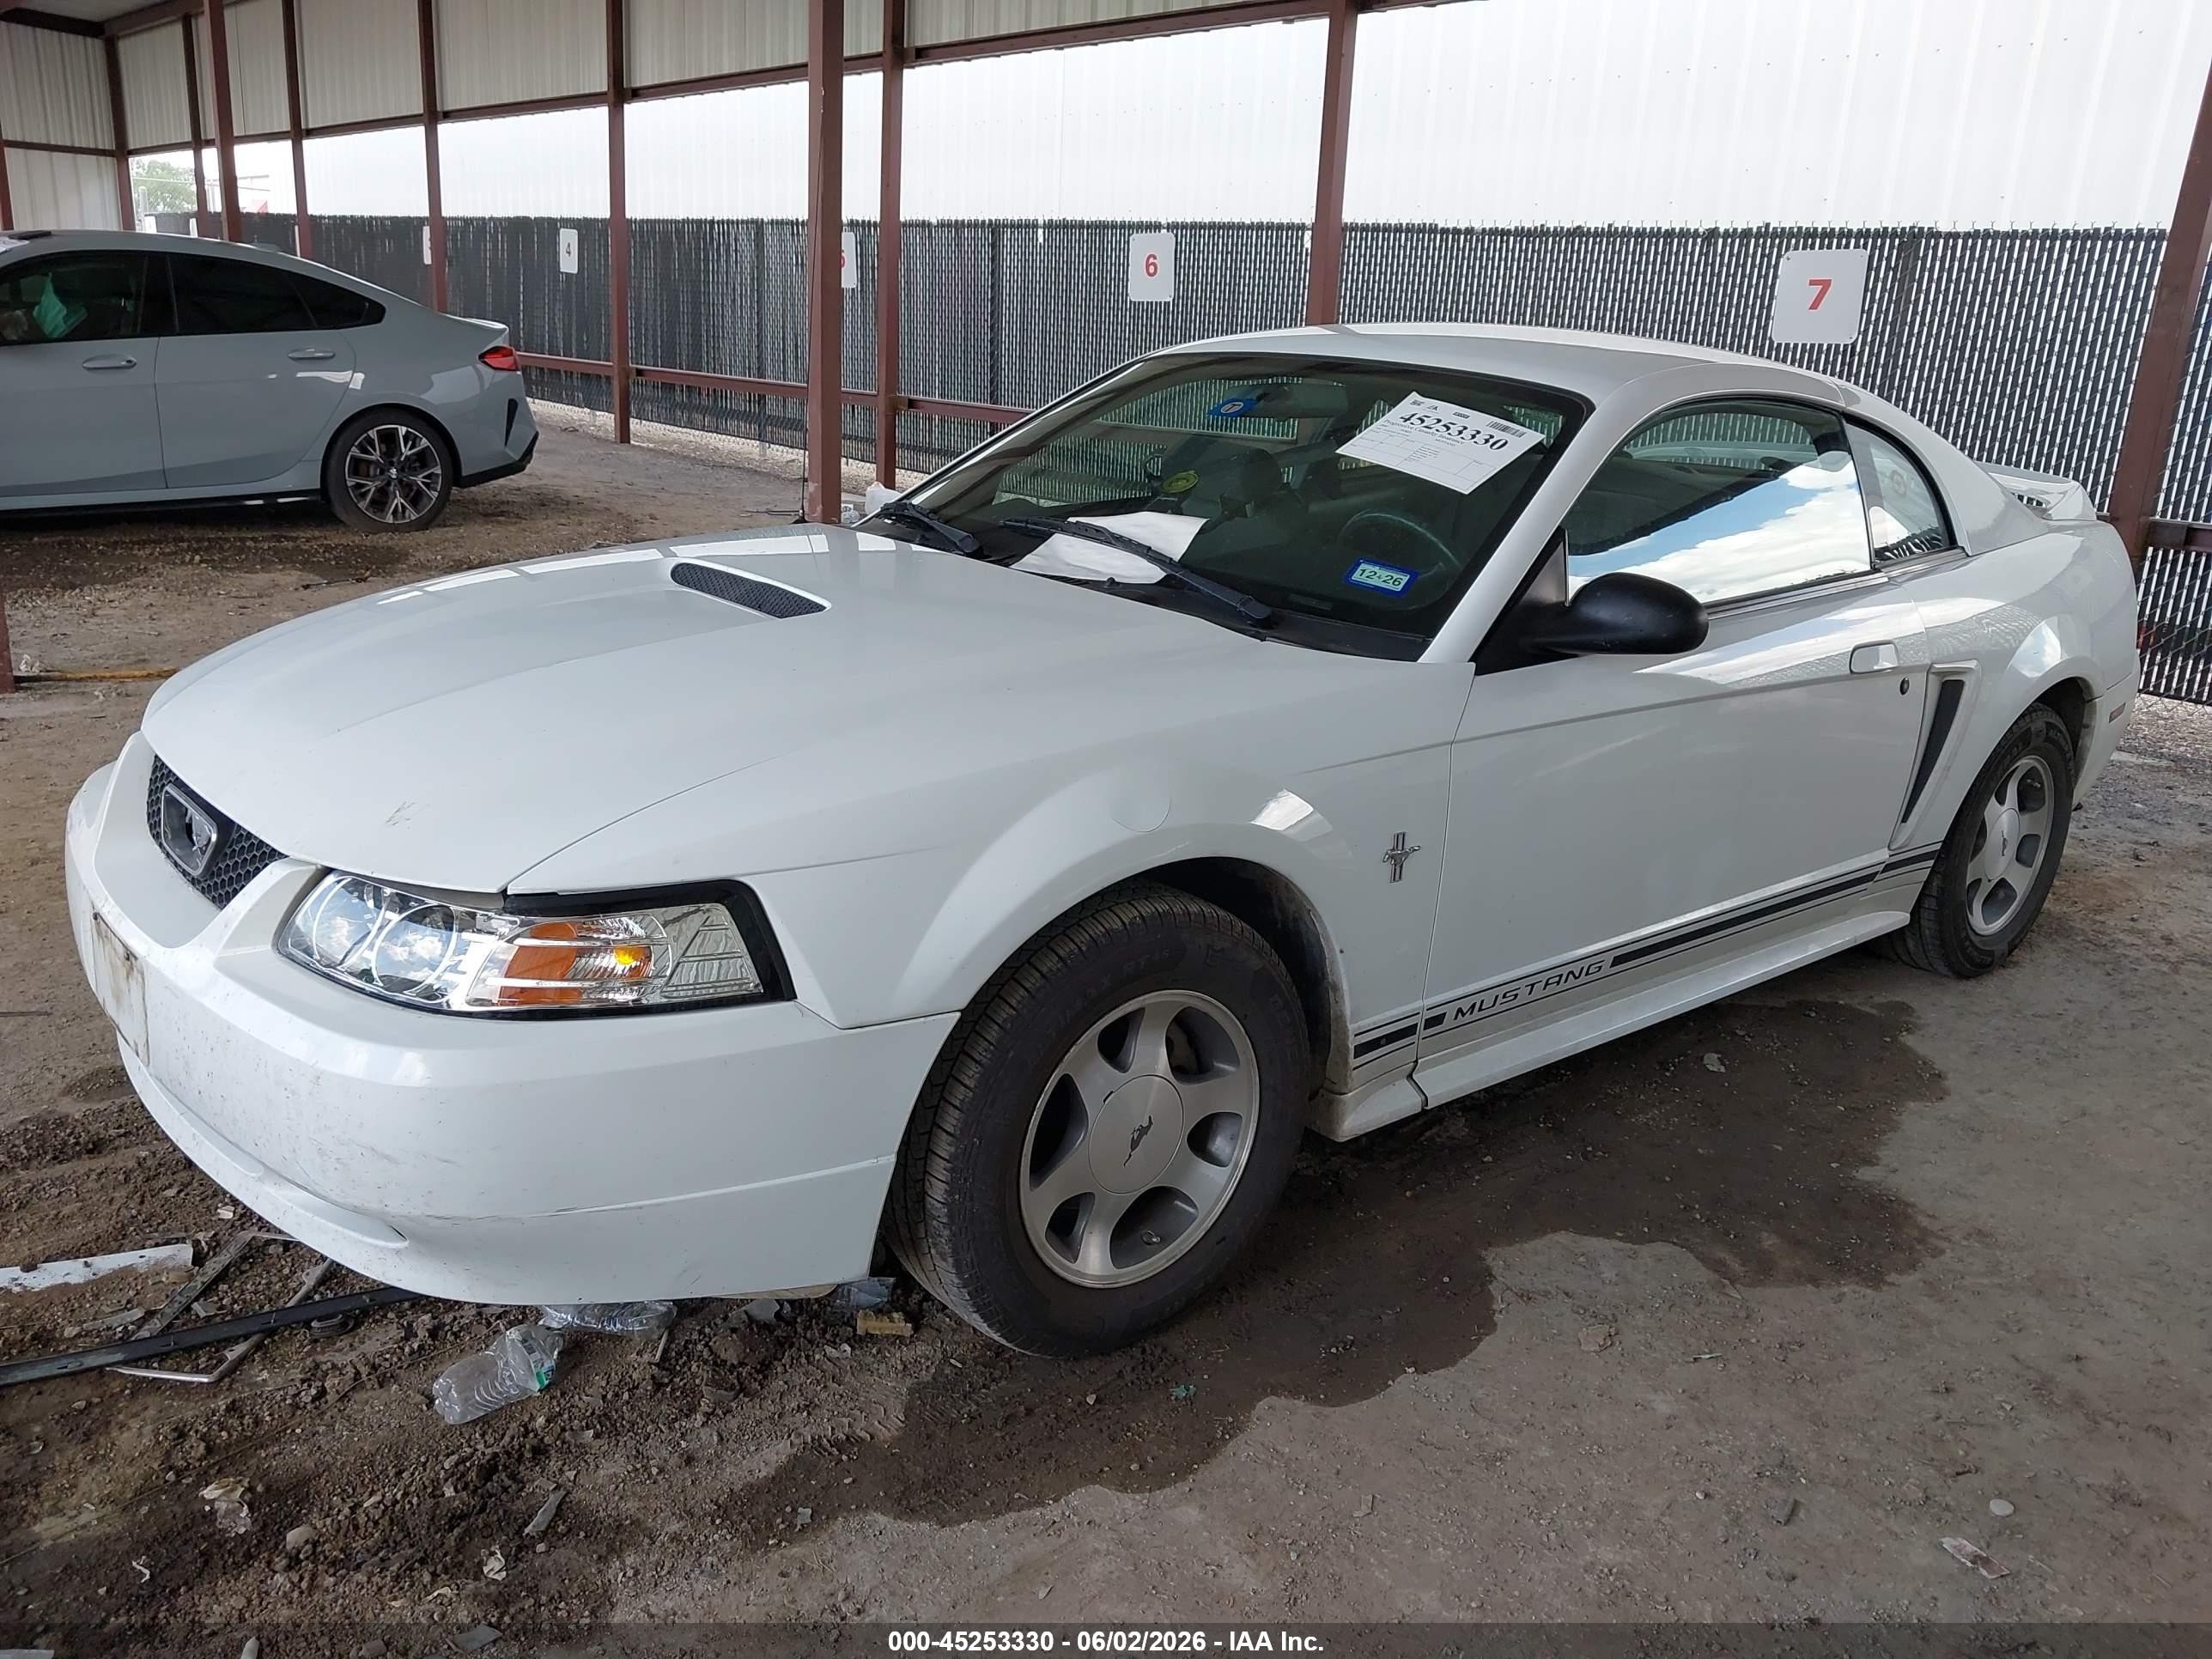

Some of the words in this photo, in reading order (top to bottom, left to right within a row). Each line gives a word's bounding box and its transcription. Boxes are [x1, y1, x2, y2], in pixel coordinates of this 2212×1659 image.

[565, 242, 571, 258] 4
[1145, 253, 1158, 277] 6
[1808, 279, 1832, 311] 7
[1400, 412, 1509, 450] 45253330
[1453, 959, 1606, 1021] MUSTANG
